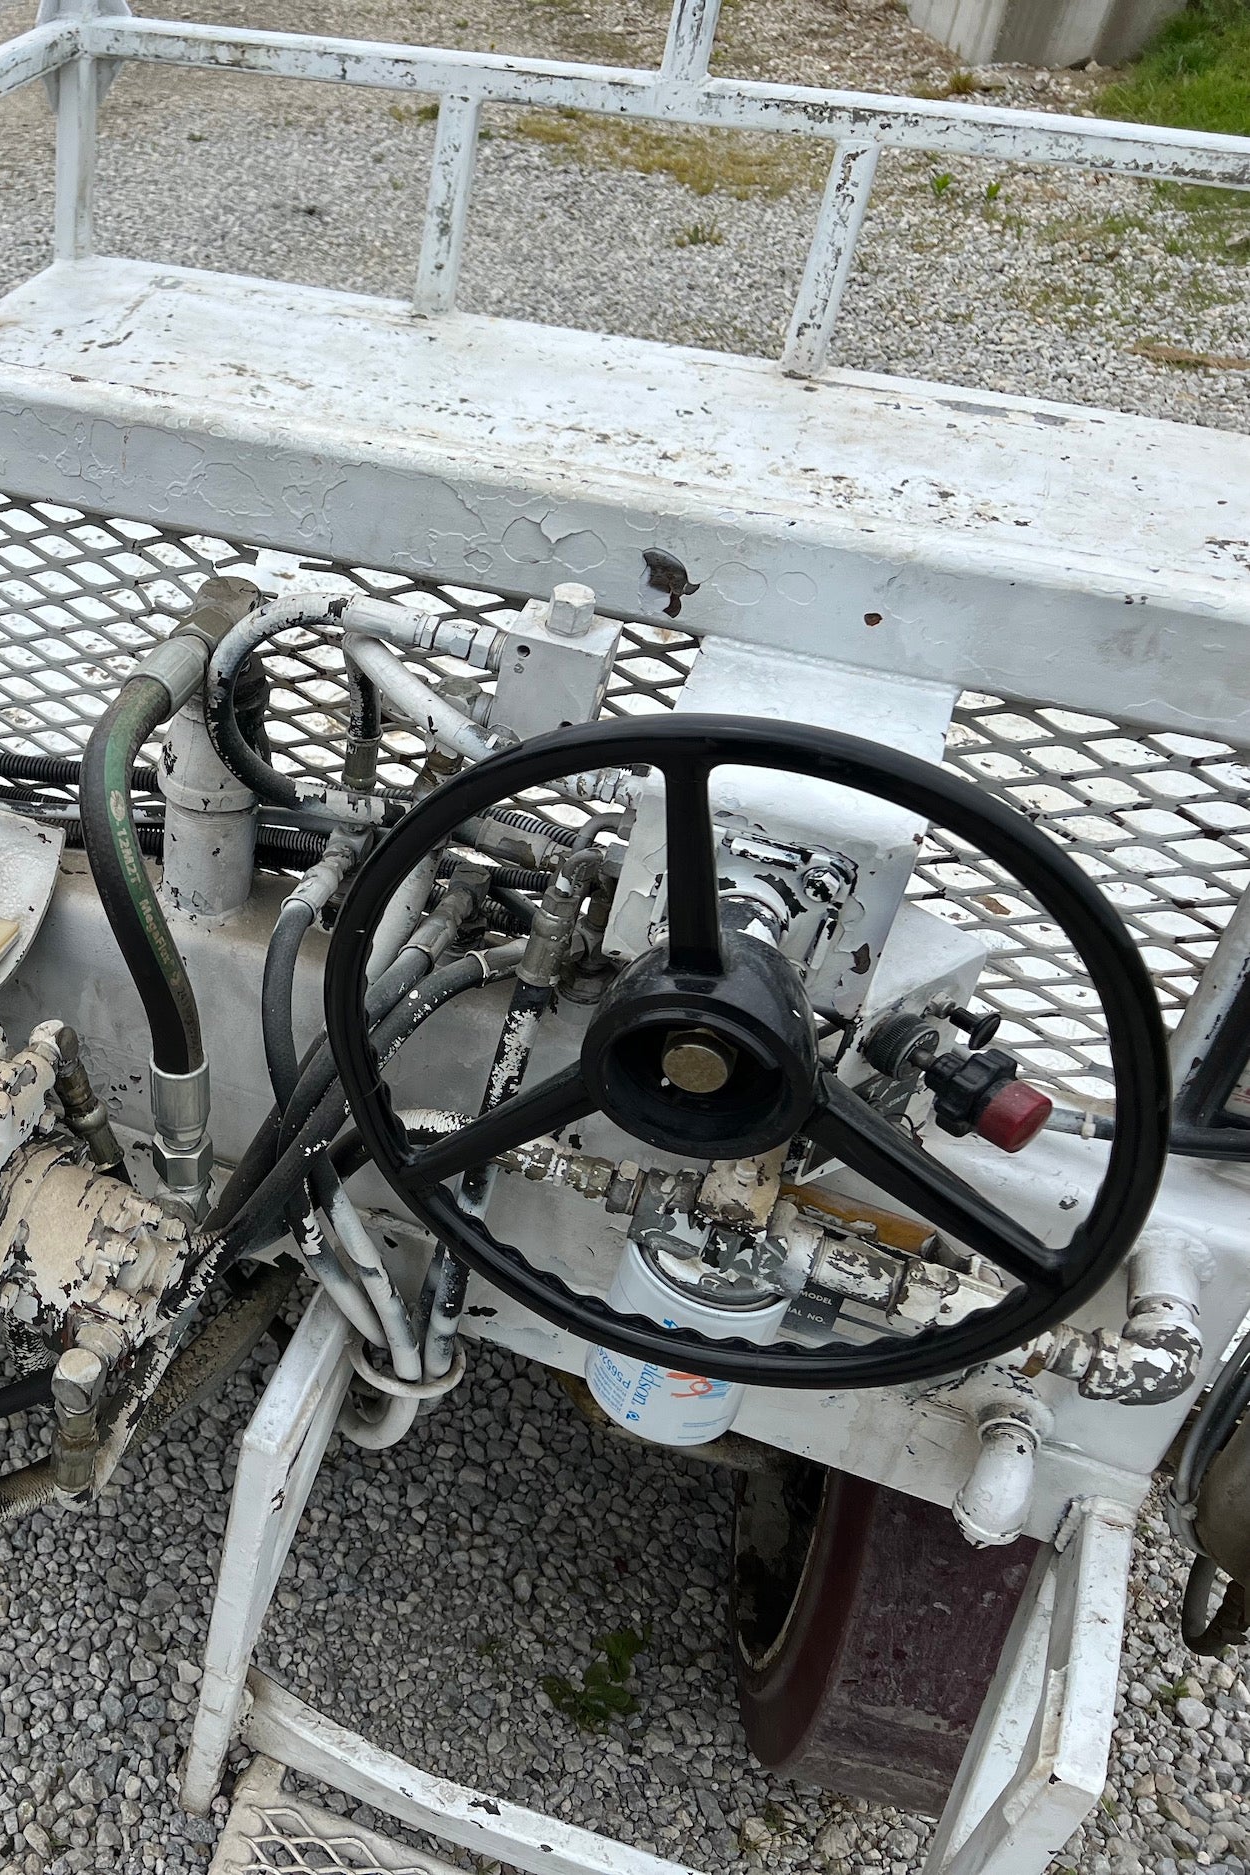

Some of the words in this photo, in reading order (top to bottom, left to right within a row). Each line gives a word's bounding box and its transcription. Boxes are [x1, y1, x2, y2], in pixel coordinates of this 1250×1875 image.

[799, 1290, 832, 1305] MODEL
[787, 1306, 802, 1316] IAL
[807, 1313, 826, 1324] NO.
[634, 1363, 665, 1405] aldson
